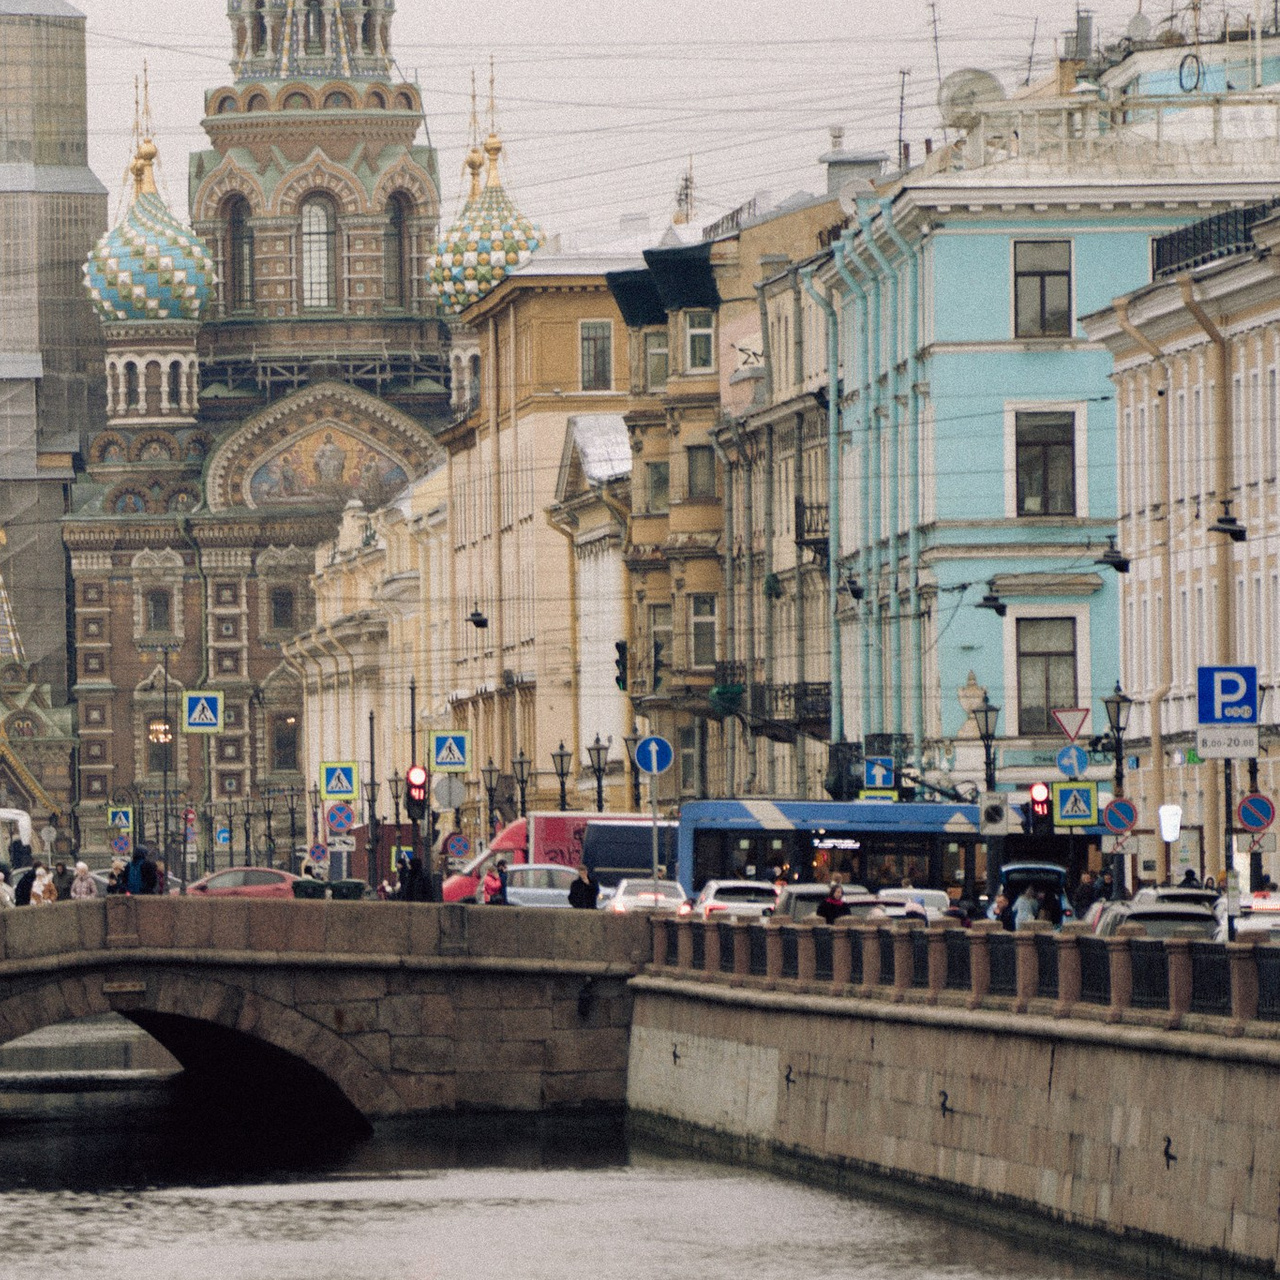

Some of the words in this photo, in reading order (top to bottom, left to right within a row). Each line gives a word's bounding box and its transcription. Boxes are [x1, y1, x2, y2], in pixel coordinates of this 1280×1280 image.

[1213, 671, 1247, 720] P
[410, 787, 425, 800] 41
[1033, 802, 1048, 815] 41
